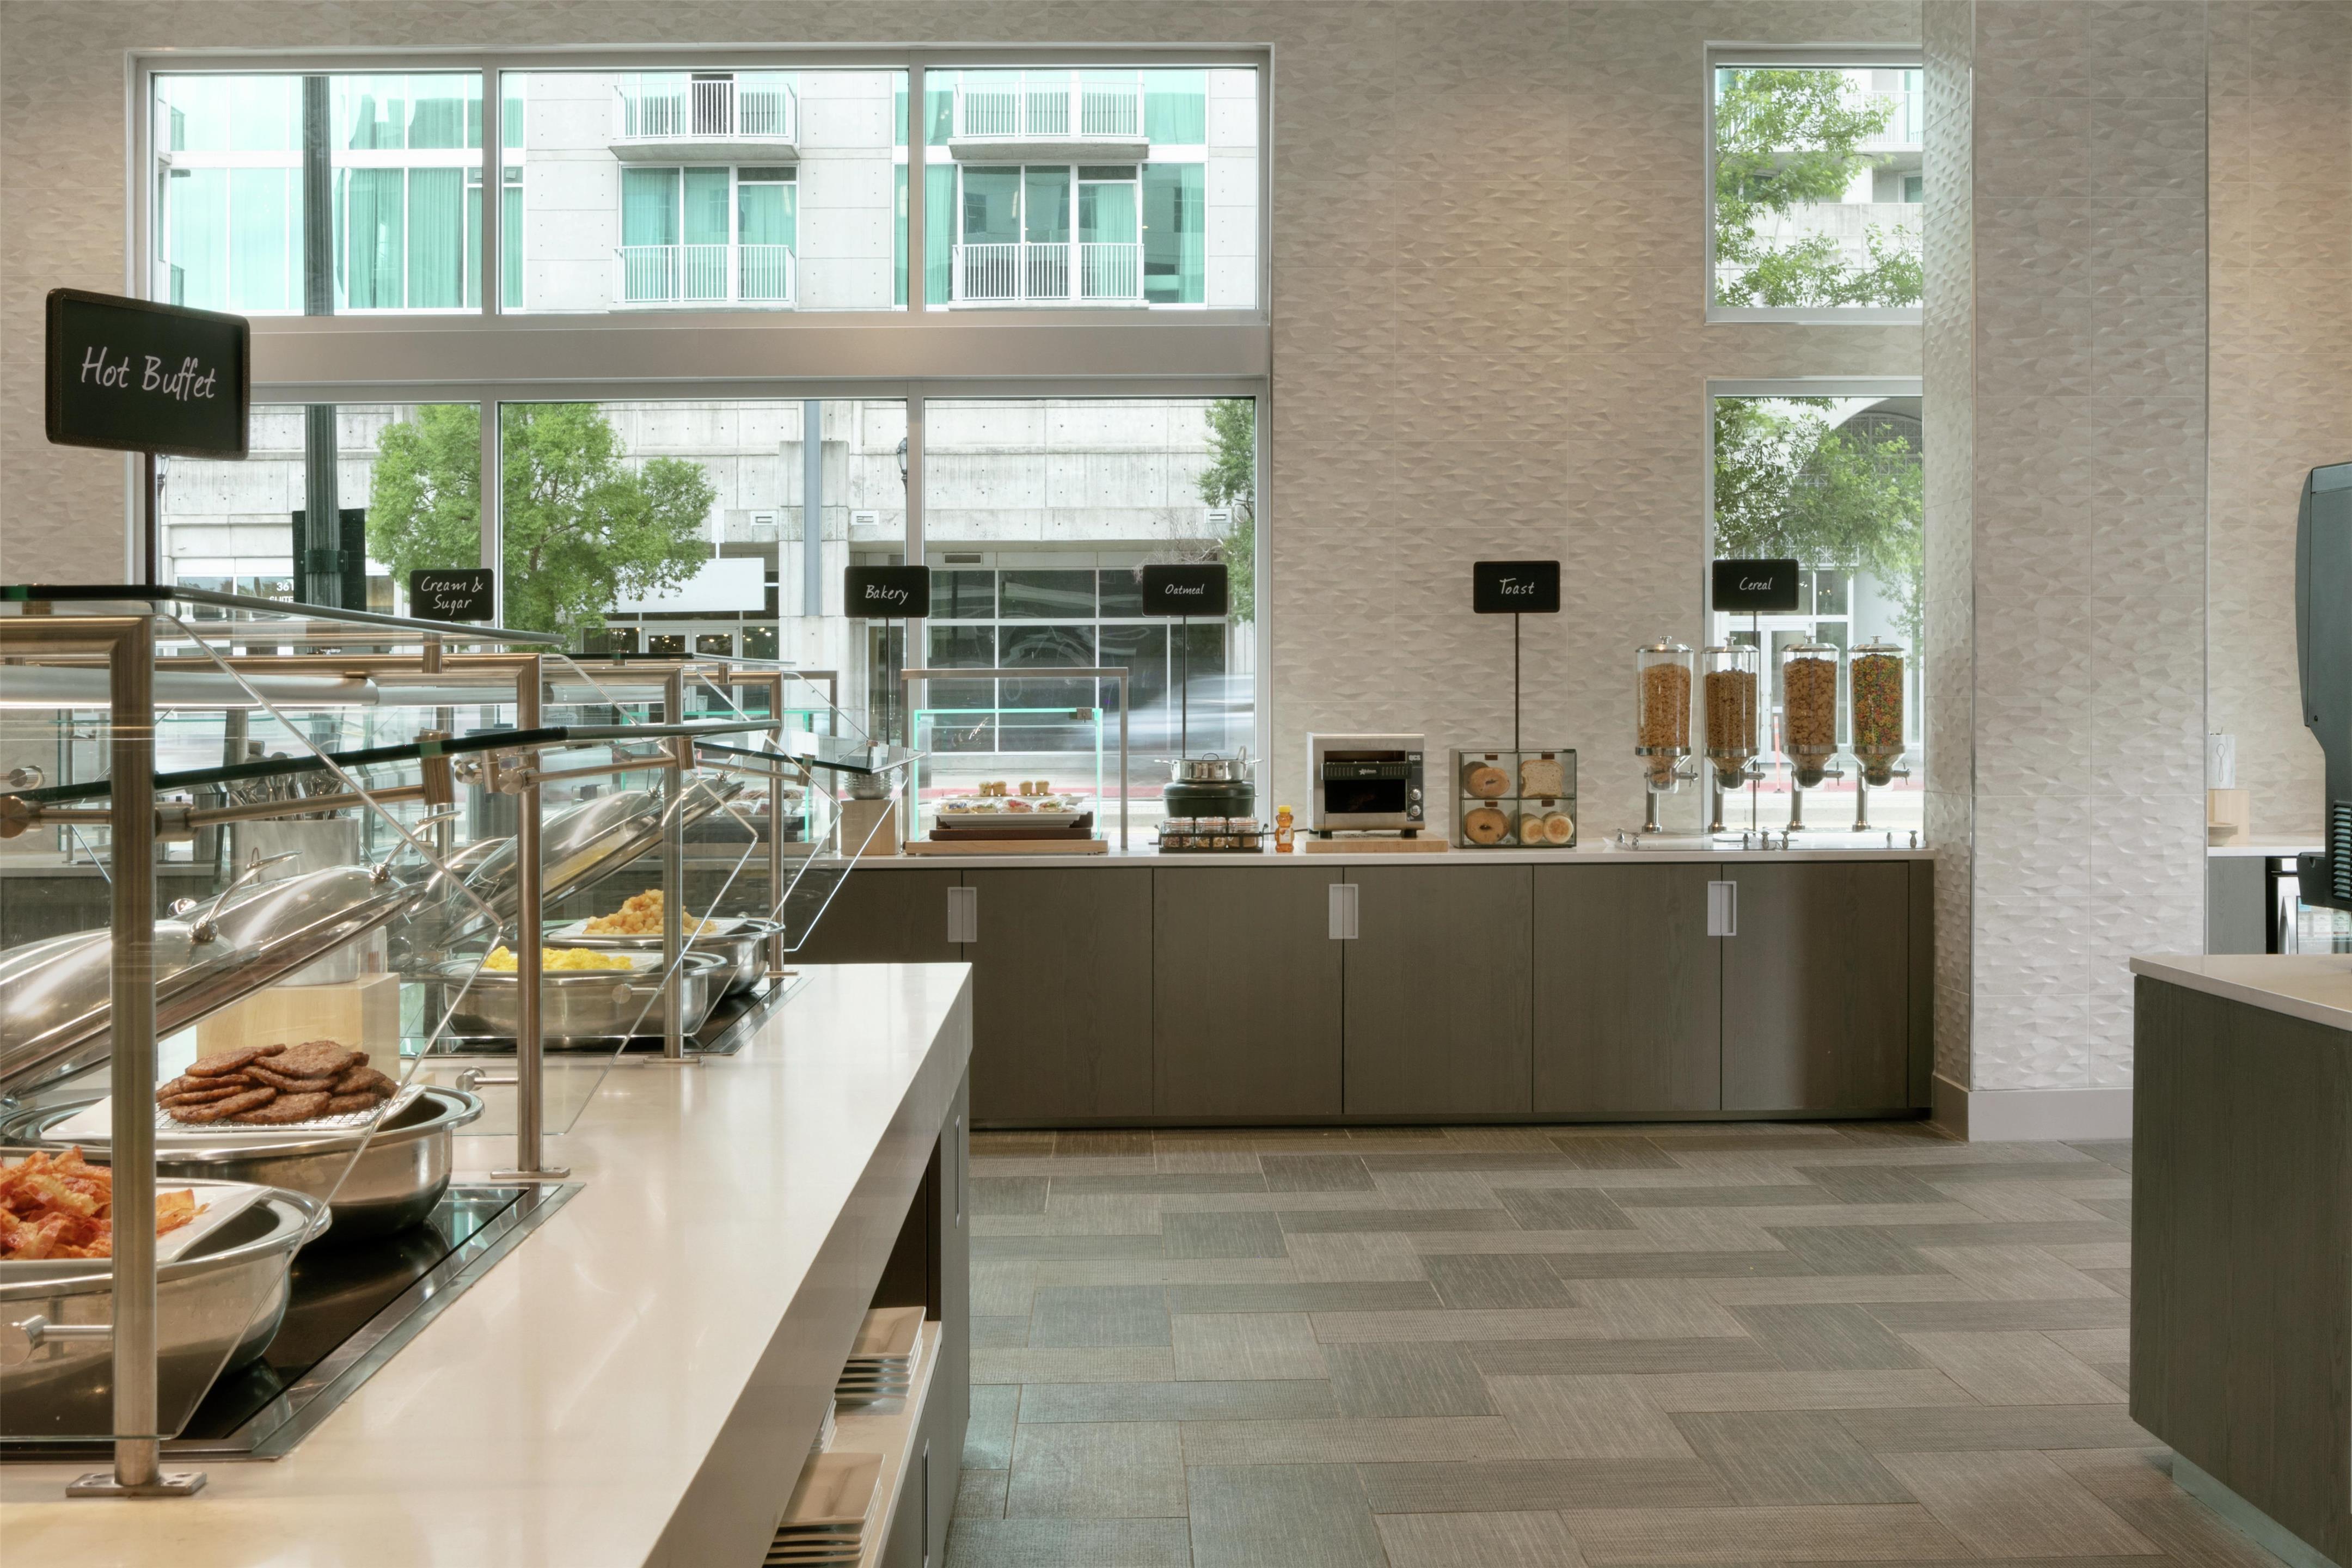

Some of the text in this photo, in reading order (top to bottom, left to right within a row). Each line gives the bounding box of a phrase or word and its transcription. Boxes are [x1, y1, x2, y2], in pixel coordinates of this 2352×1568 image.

[81, 346, 217, 401] Hot Buffet
[421, 576, 483, 593] Cream &
[1165, 583, 1205, 595] Oatmeal
[1499, 578, 1534, 595] Toast
[1739, 577, 1773, 591] Cereal
[865, 584, 909, 605] Bakery
[433, 593, 472, 616] Sugar
